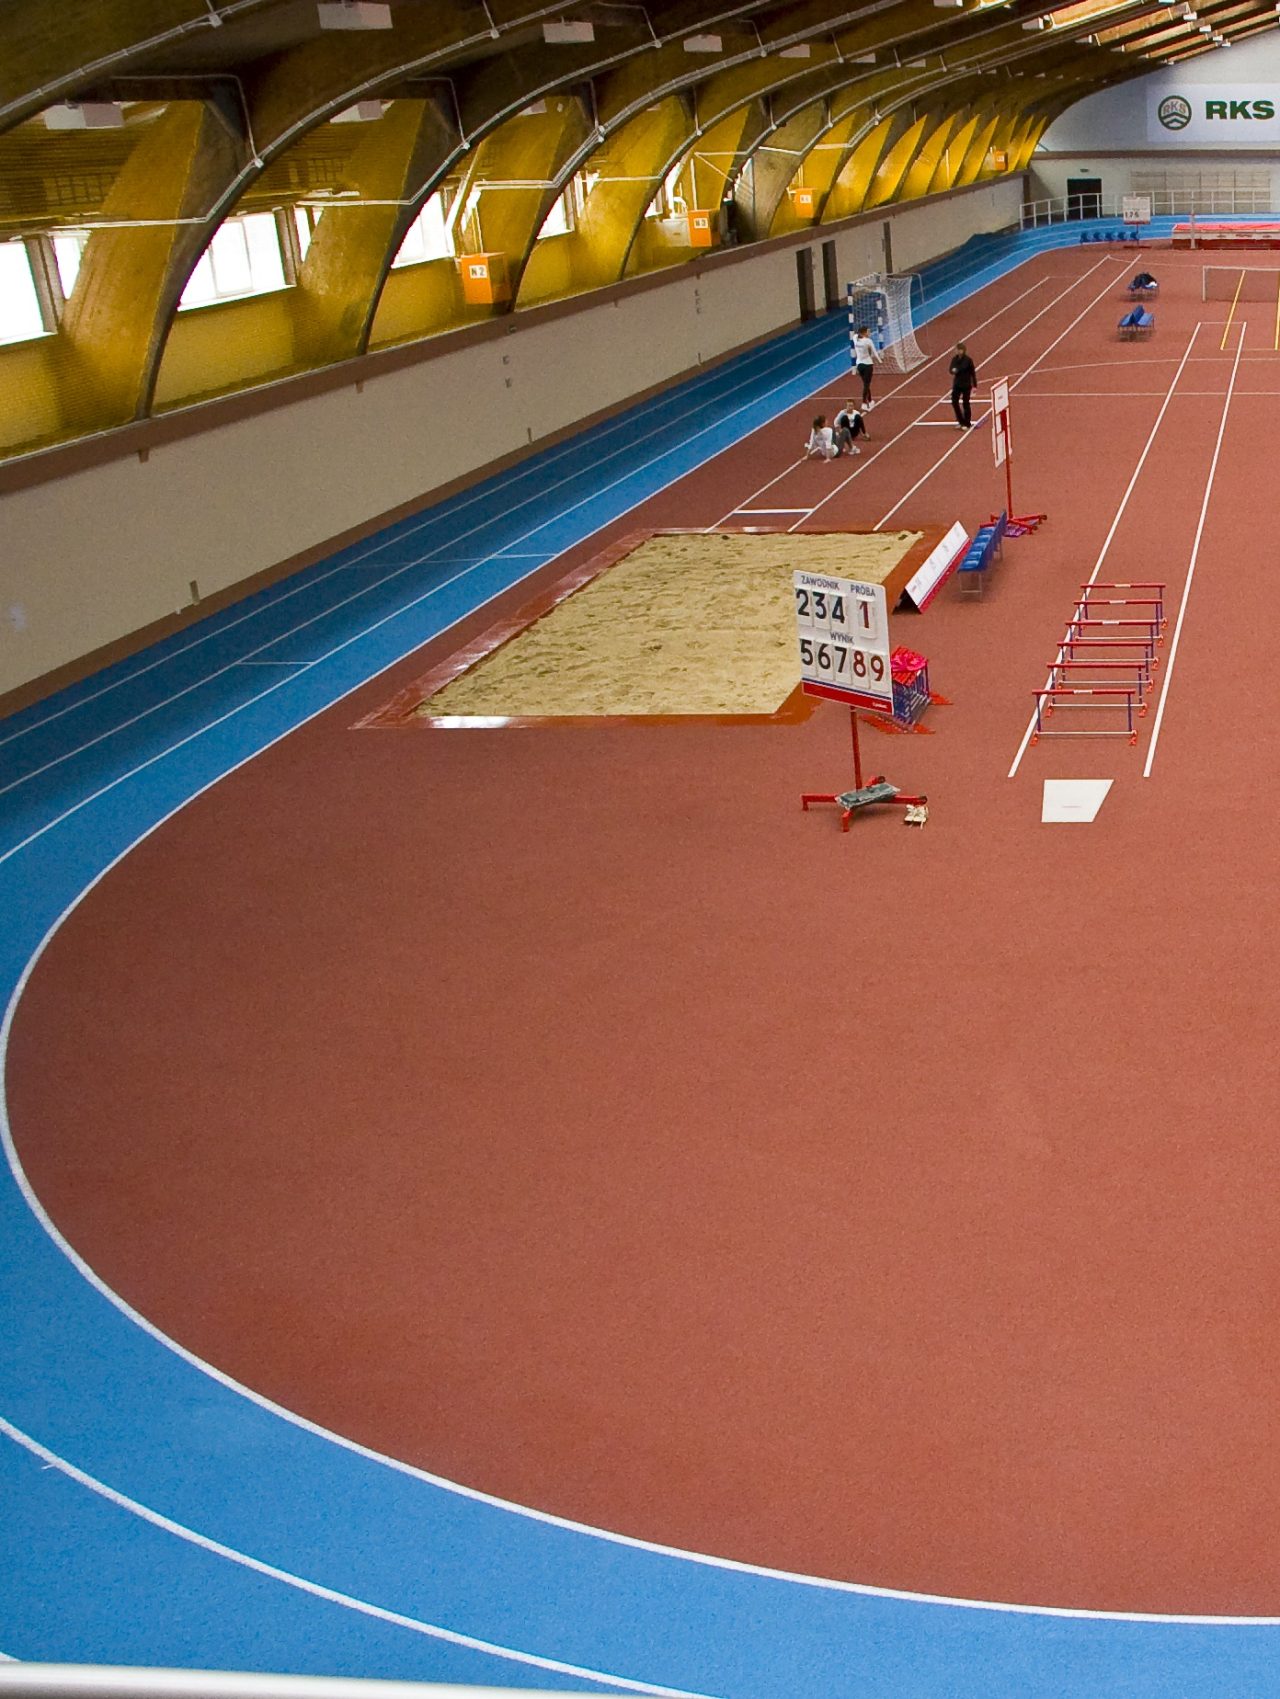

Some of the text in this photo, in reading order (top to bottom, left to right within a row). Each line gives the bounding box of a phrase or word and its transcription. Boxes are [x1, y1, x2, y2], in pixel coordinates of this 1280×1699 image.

[1162, 100, 1187, 115] RKS
[1205, 100, 1275, 120] RKS
[801, 575, 876, 597] ZAWODNIK PRÓBA
[859, 601, 870, 629] 1
[830, 633, 855, 645] WYNIK
